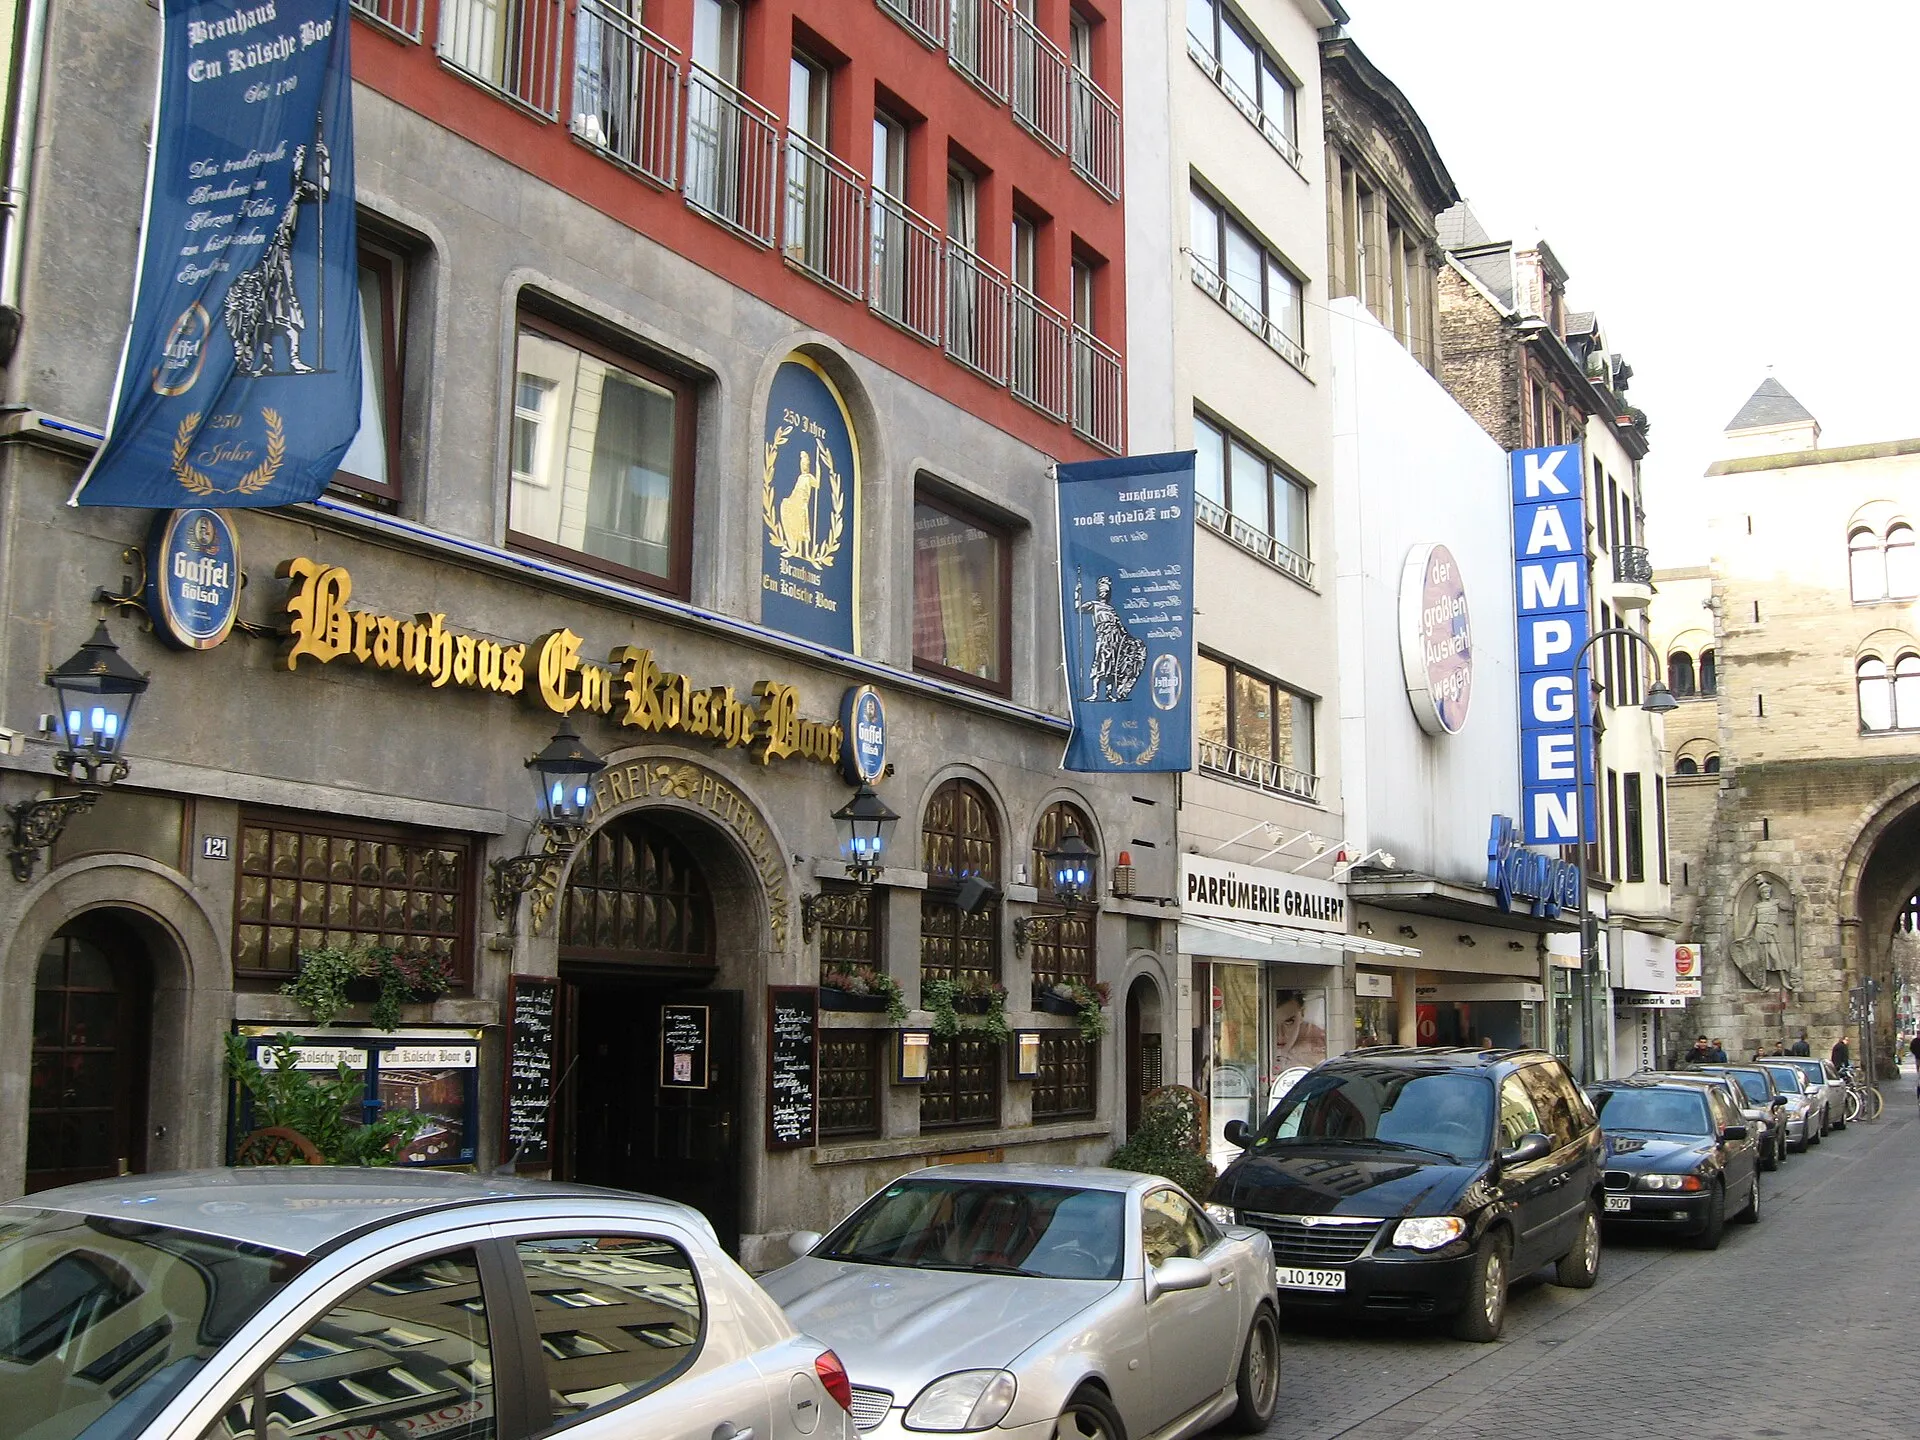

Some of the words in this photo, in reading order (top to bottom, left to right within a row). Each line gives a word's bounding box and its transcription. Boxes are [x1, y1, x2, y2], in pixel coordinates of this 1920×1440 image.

[187, 0, 277, 48] Brauhaus
[187, 60, 222, 82] Em
[227, 35, 296, 73] Kölsche
[299, 17, 334, 51] Boo
[783, 408, 800, 427] 250
[801, 417, 827, 441] Jahre
[174, 551, 229, 589] Gaffel
[779, 558, 822, 587] Brauhaus
[1432, 559, 1452, 585] der
[762, 574, 778, 592] Em
[780, 577, 814, 605] Kölsche
[814, 590, 838, 612] Boor
[1424, 595, 1466, 637] größten
[286, 557, 527, 696] Brauhaus
[538, 627, 613, 714] Em
[621, 644, 757, 749] Kölsche
[763, 680, 843, 766] Boor
[1426, 624, 1471, 666] Auswahl
[1521, 450, 1580, 840] KÄMPGEN
[1433, 667, 1471, 702] wegen
[858, 722, 883, 745] Gaffel
[697, 774, 756, 838] PETER
[205, 837, 227, 857] 121
[1187, 871, 1280, 914] PARFÜMERIE
[1283, 889, 1344, 923] GRALLERT
[1627, 995, 1665, 1005] Lexmark
[437, 1049, 461, 1063] Boor
[1610, 1198, 1629, 1209] 907
[1308, 1271, 1343, 1287] 1929
